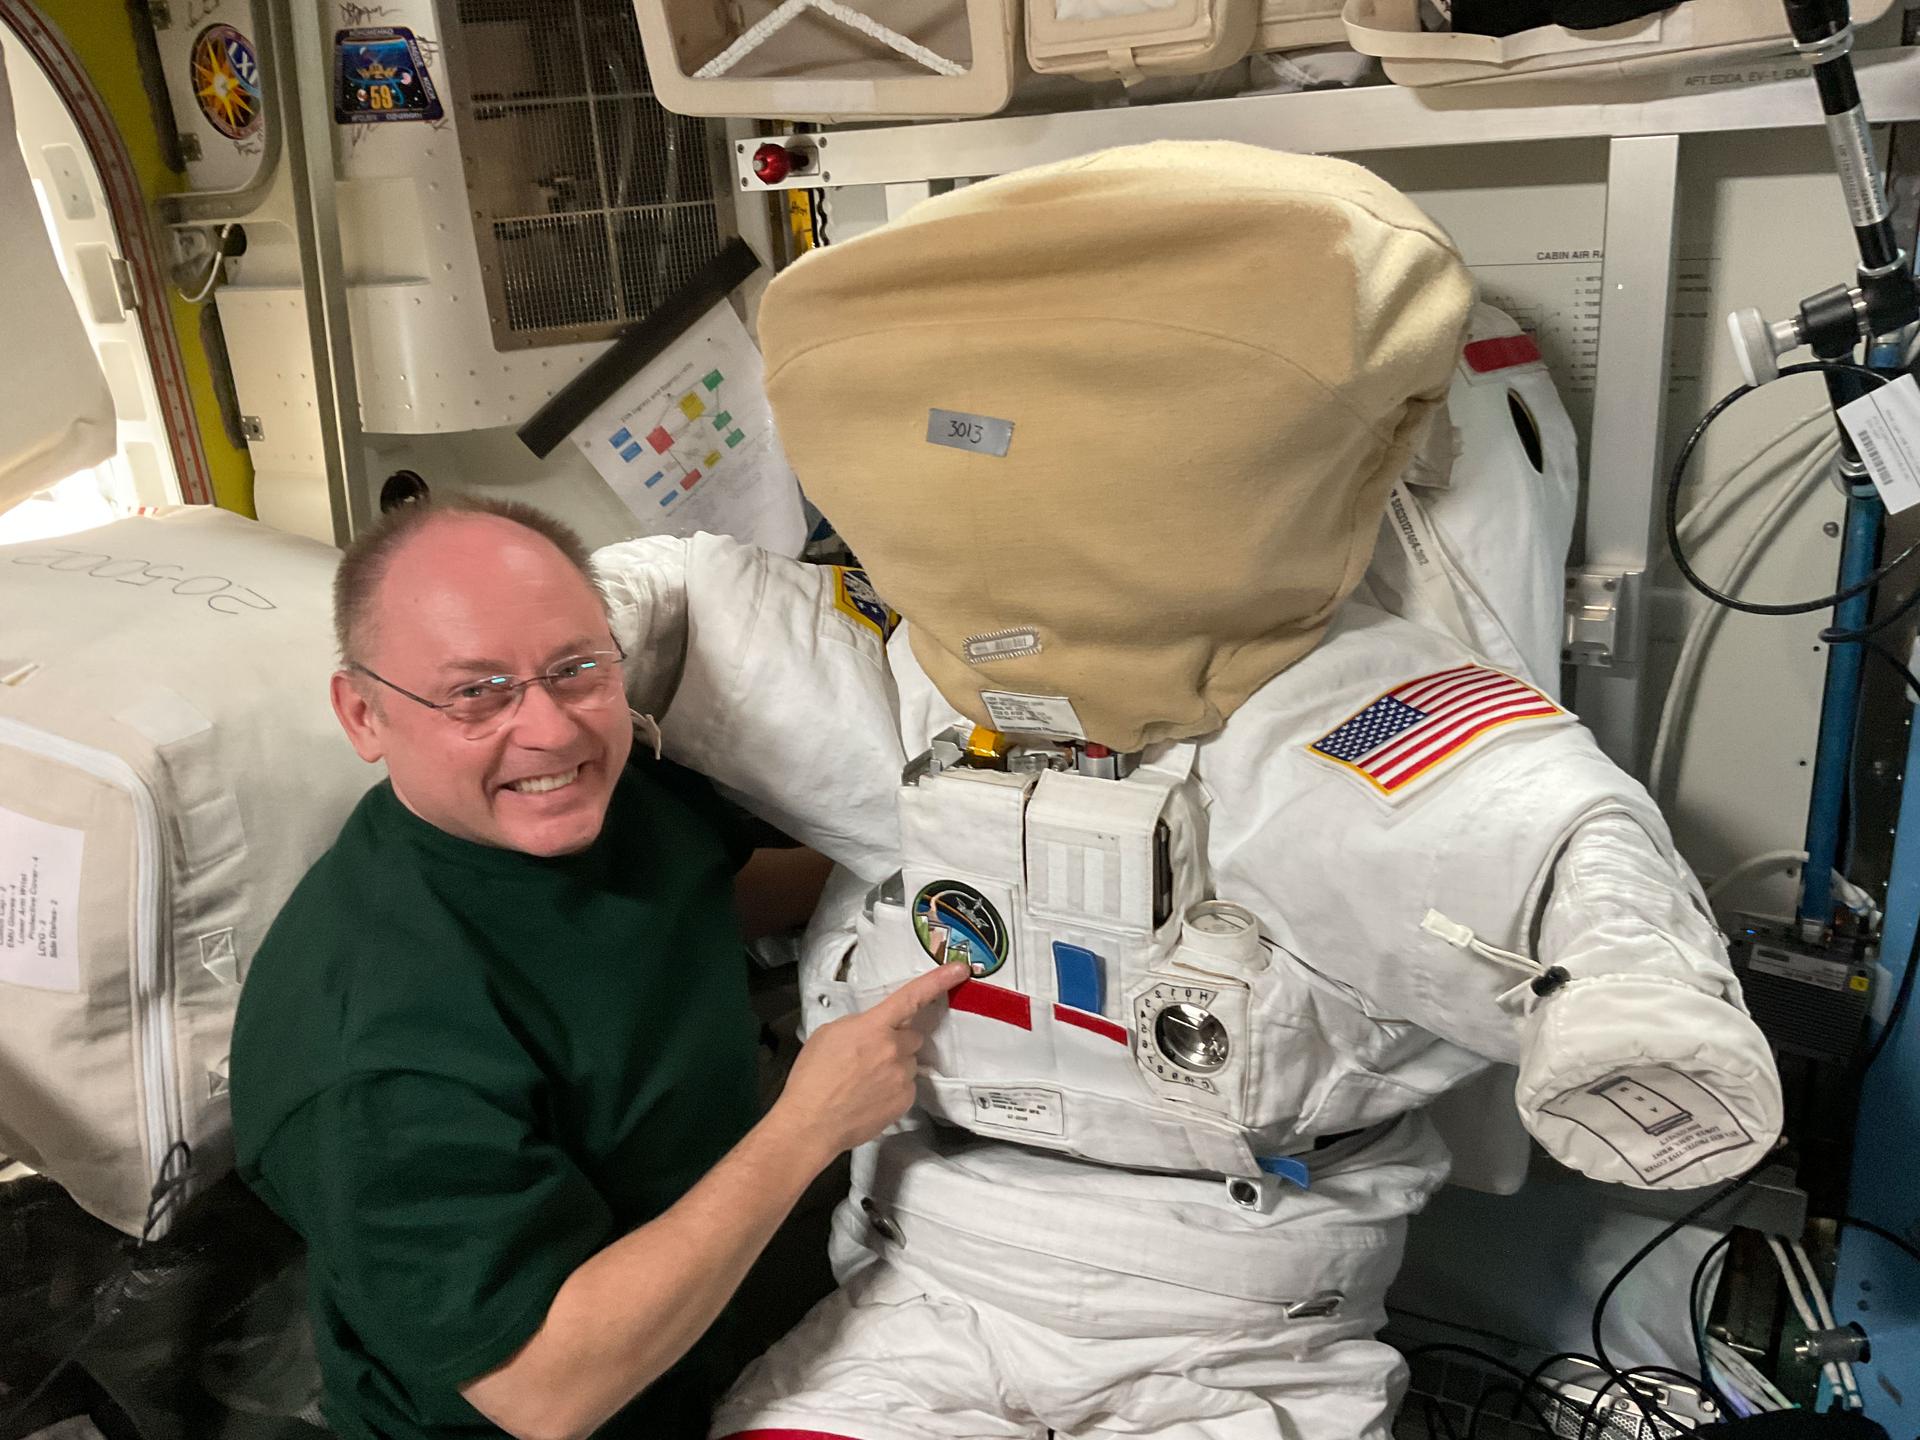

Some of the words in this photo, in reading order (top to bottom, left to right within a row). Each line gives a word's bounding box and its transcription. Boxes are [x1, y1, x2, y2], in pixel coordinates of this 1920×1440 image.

[1684, 76, 1707, 86] AFT
[370, 85, 393, 109] 59
[1537, 251, 1569, 260] CABIN
[1572, 250, 1590, 259] AIR
[948, 420, 983, 444] 3013
[29, 870, 38, 895] Cover
[18, 898, 26, 915] Arm
[28, 897, 36, 940] Protective
[7, 929, 15, 948] EMU
[49, 940, 57, 958] Side
[1695, 1126, 1720, 1137] LOWER
[1643, 1159, 1668, 1173] COVER
